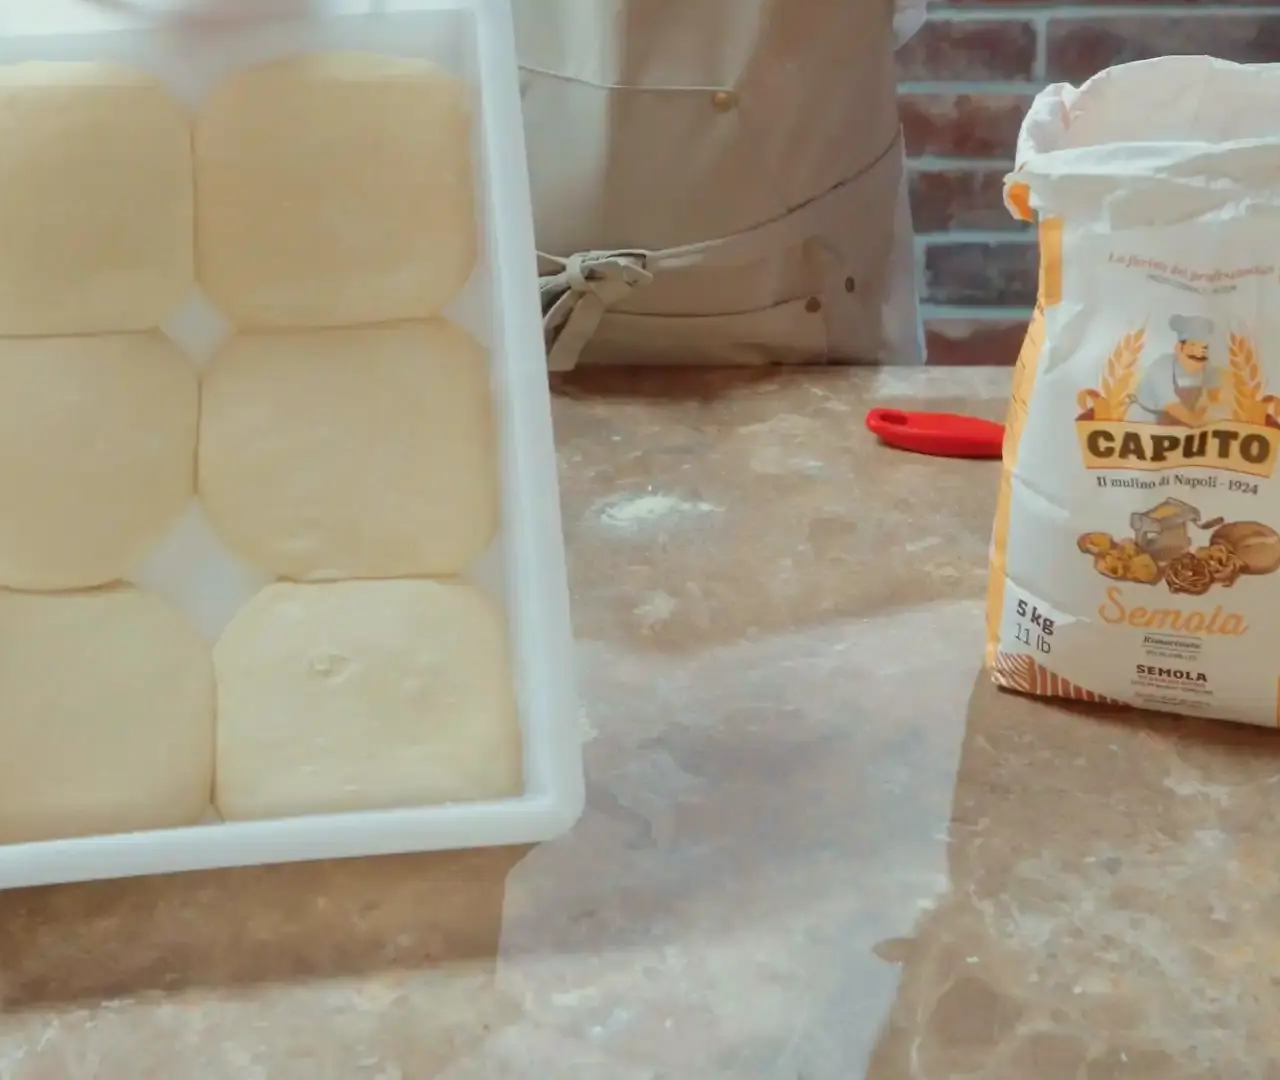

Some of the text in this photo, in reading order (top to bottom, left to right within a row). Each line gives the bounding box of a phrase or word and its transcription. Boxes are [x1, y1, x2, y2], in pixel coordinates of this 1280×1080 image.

[1087, 429, 1270, 464] CAPUTO
[1110, 475, 1156, 490] mulino
[1158, 474, 1170, 487] di
[1173, 473, 1218, 489] Napoli
[1227, 478, 1259, 496] 1924
[1016, 598, 1055, 636] 5 kg
[1098, 586, 1250, 636] Semola
[1015, 622, 1051, 654] 11 lb
[1136, 663, 1208, 683] SEMOLA
